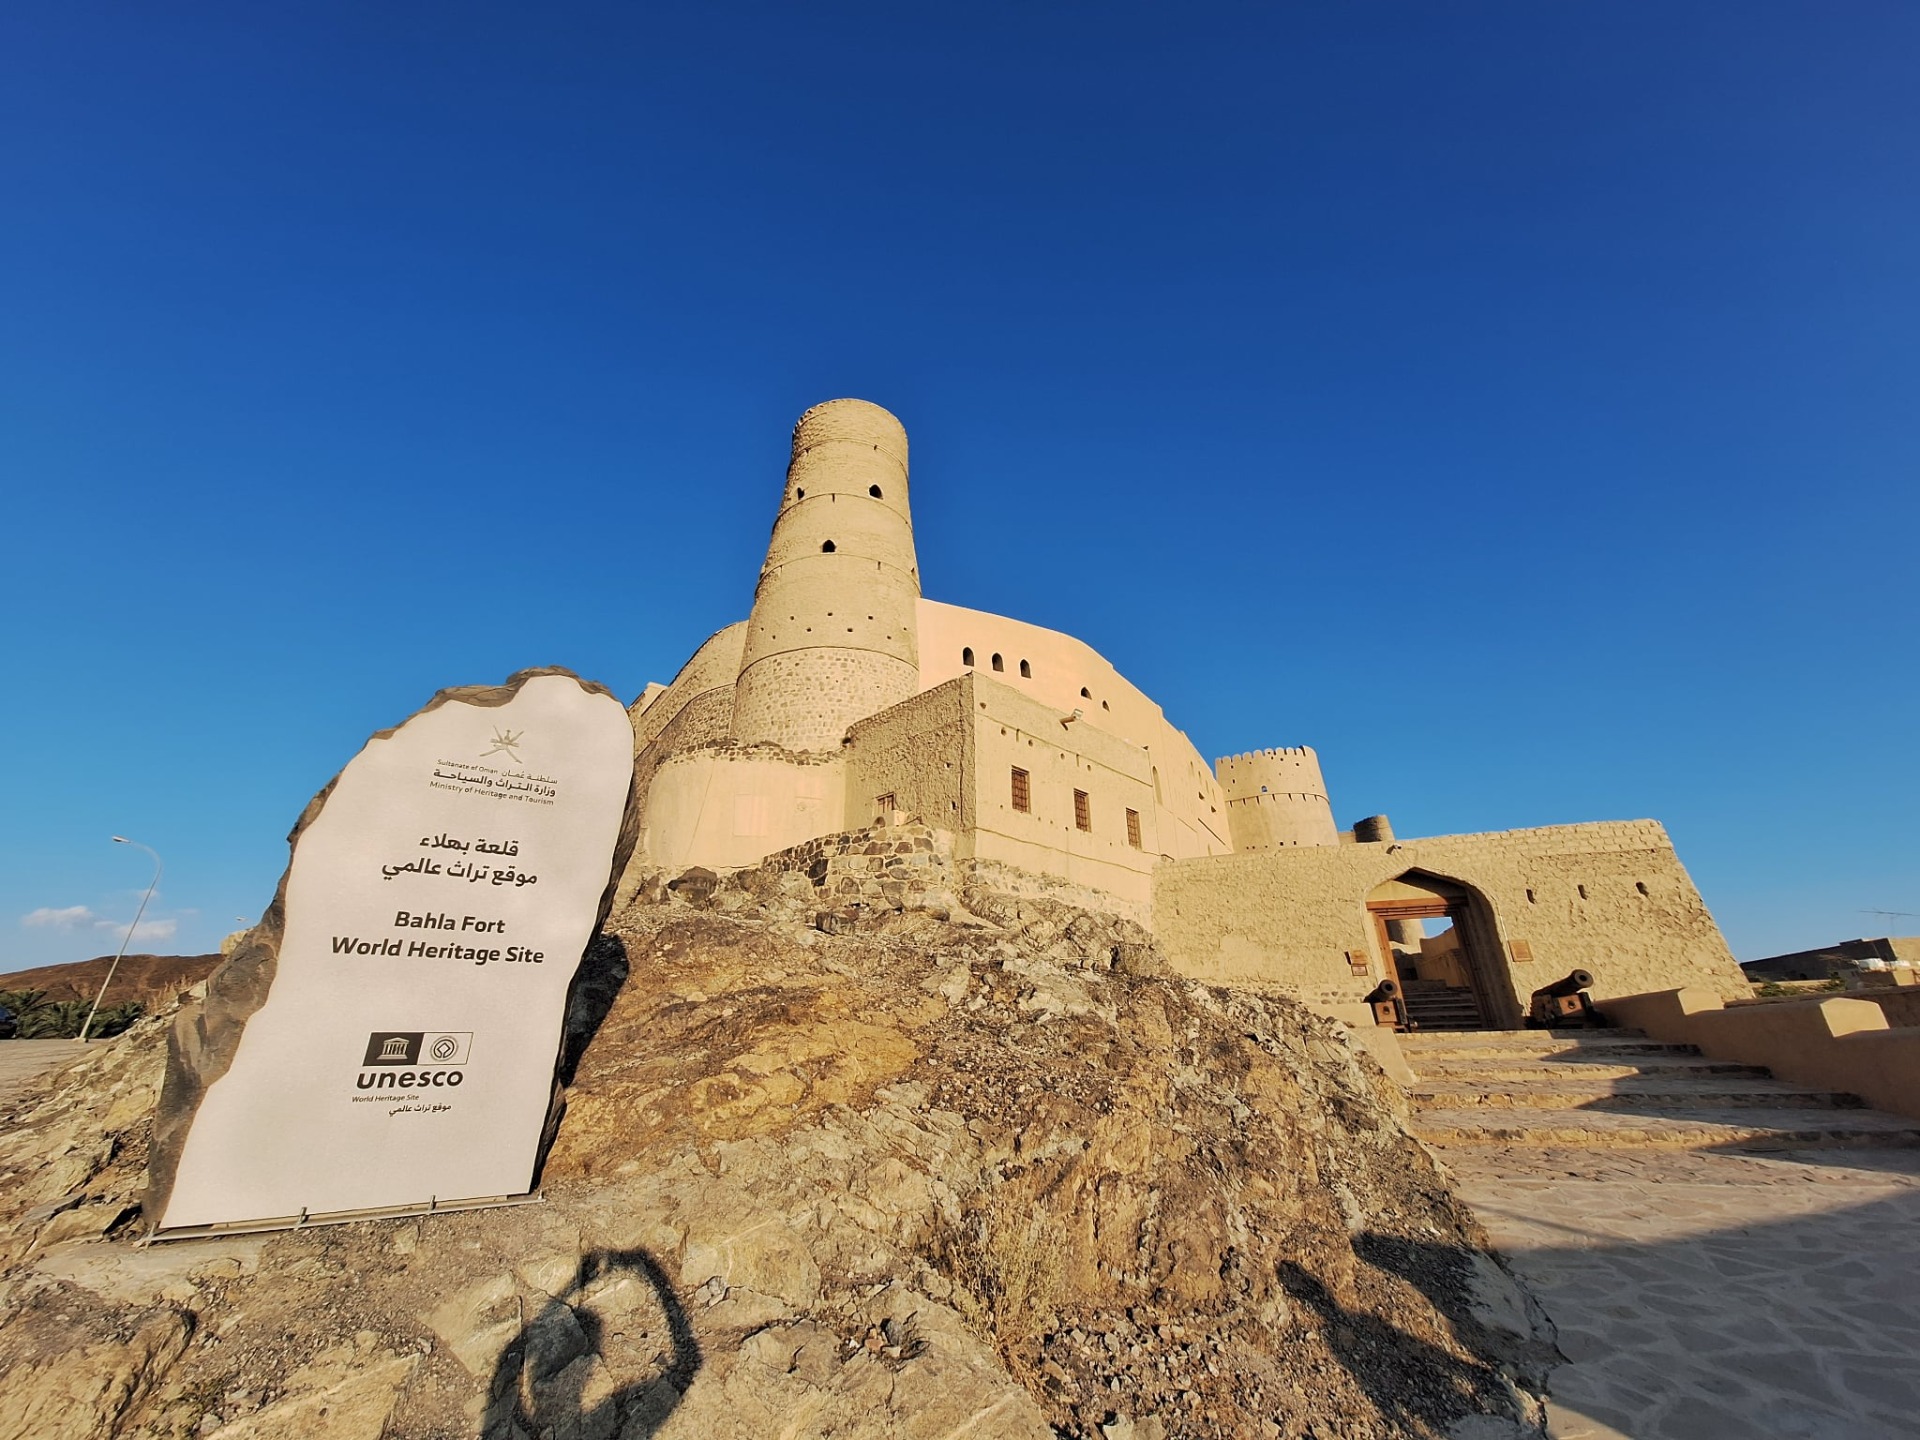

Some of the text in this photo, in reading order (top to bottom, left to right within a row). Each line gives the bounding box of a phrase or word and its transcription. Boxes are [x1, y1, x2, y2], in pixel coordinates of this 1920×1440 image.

[437, 759, 469, 769] Sultanate
[479, 766, 498, 774] Oman
[433, 769, 556, 797] وزارة التراث والسياحة
[527, 774, 557, 784] سلطنة
[430, 781, 462, 793] Ministry
[475, 788, 507, 799] Heritage
[524, 795, 554, 805] Tourism
[420, 833, 519, 857] قلعة بهلاء
[382, 857, 538, 886] موقع تراث عالمي
[394, 911, 505, 933] Bahla Fort
[332, 936, 544, 965] World Heritage Site
[356, 1071, 463, 1089] unesco
[389, 1103, 451, 1117] موقع تراث عالمي
